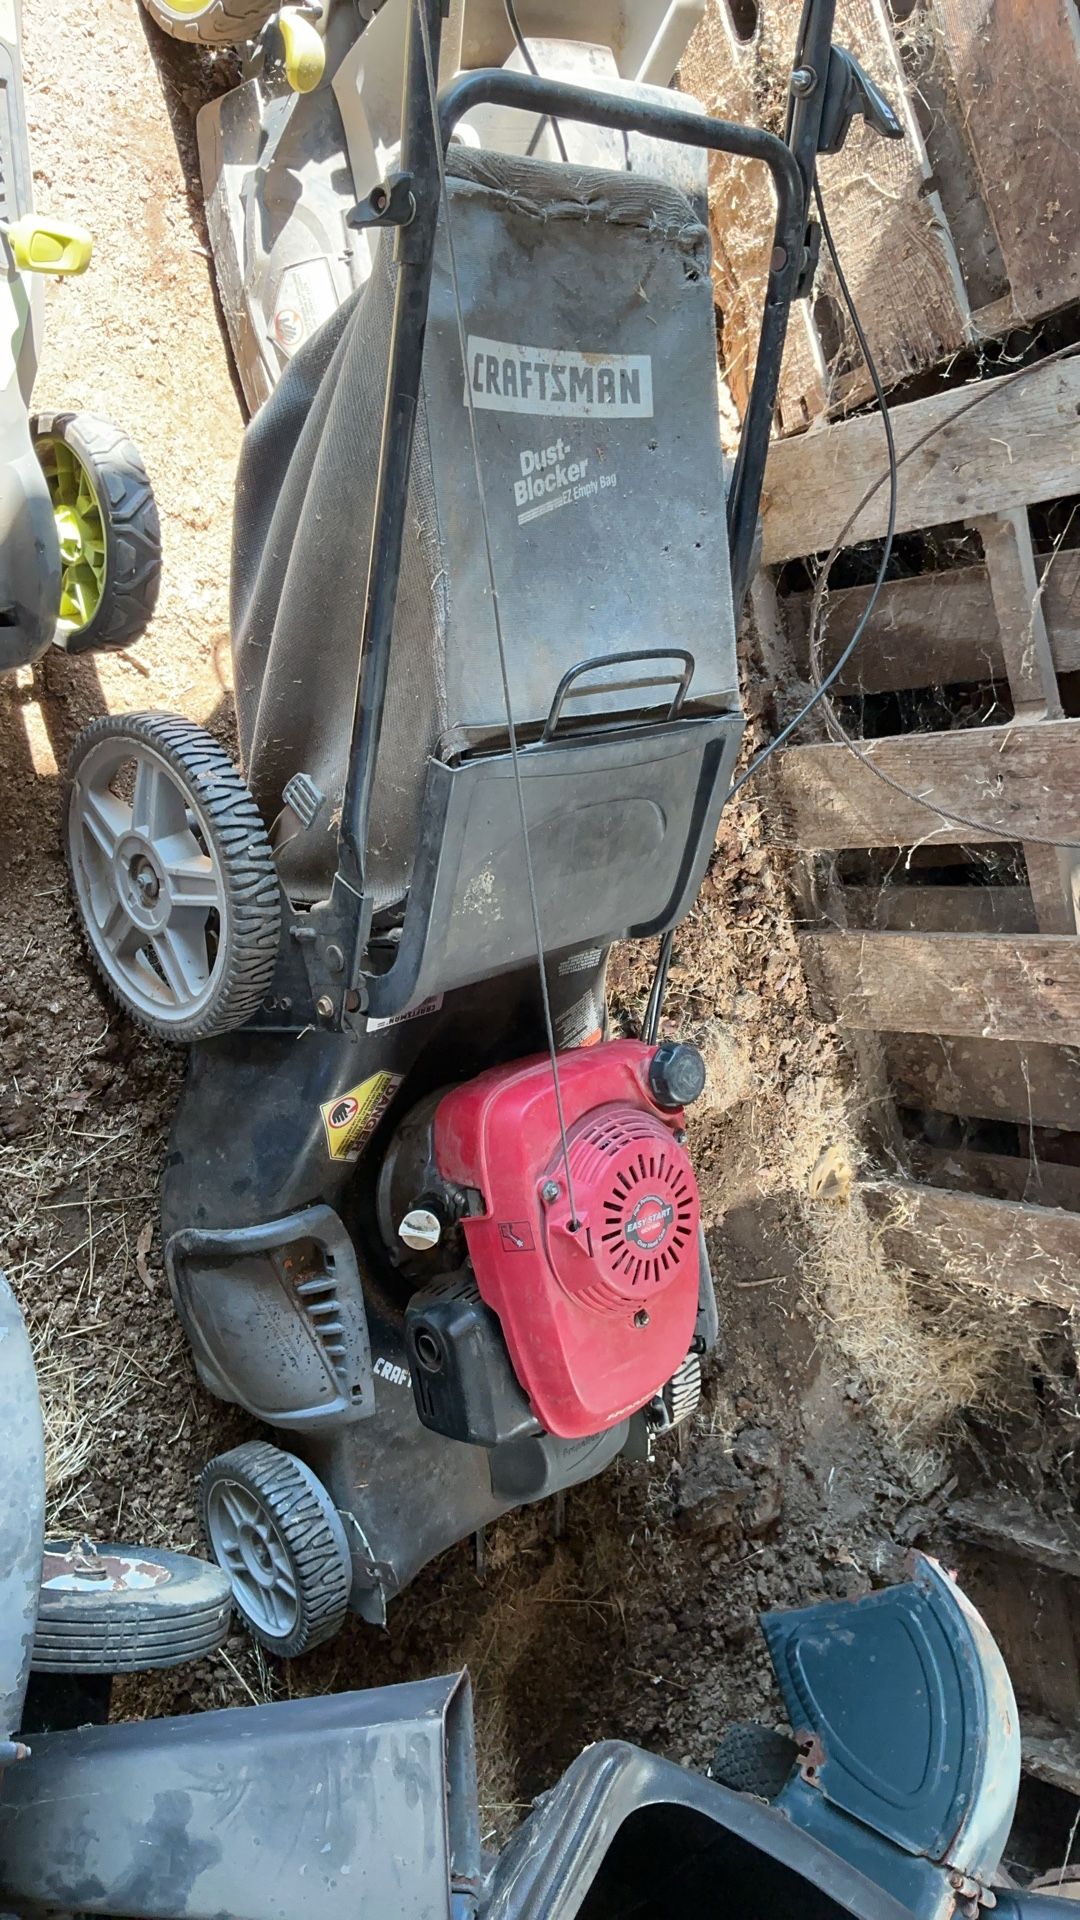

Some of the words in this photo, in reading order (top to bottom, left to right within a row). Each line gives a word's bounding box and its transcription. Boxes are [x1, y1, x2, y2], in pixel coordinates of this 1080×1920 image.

[473, 353, 641, 404] CRAFTSMAN
[520, 438, 571, 476] Dust-
[514, 458, 589, 506] Blocker
[573, 482, 599, 500] Empty
[600, 472, 617, 488] Bag
[388, 1004, 436, 1025] CRAFTSMAN
[351, 1083, 399, 1153] DANGER
